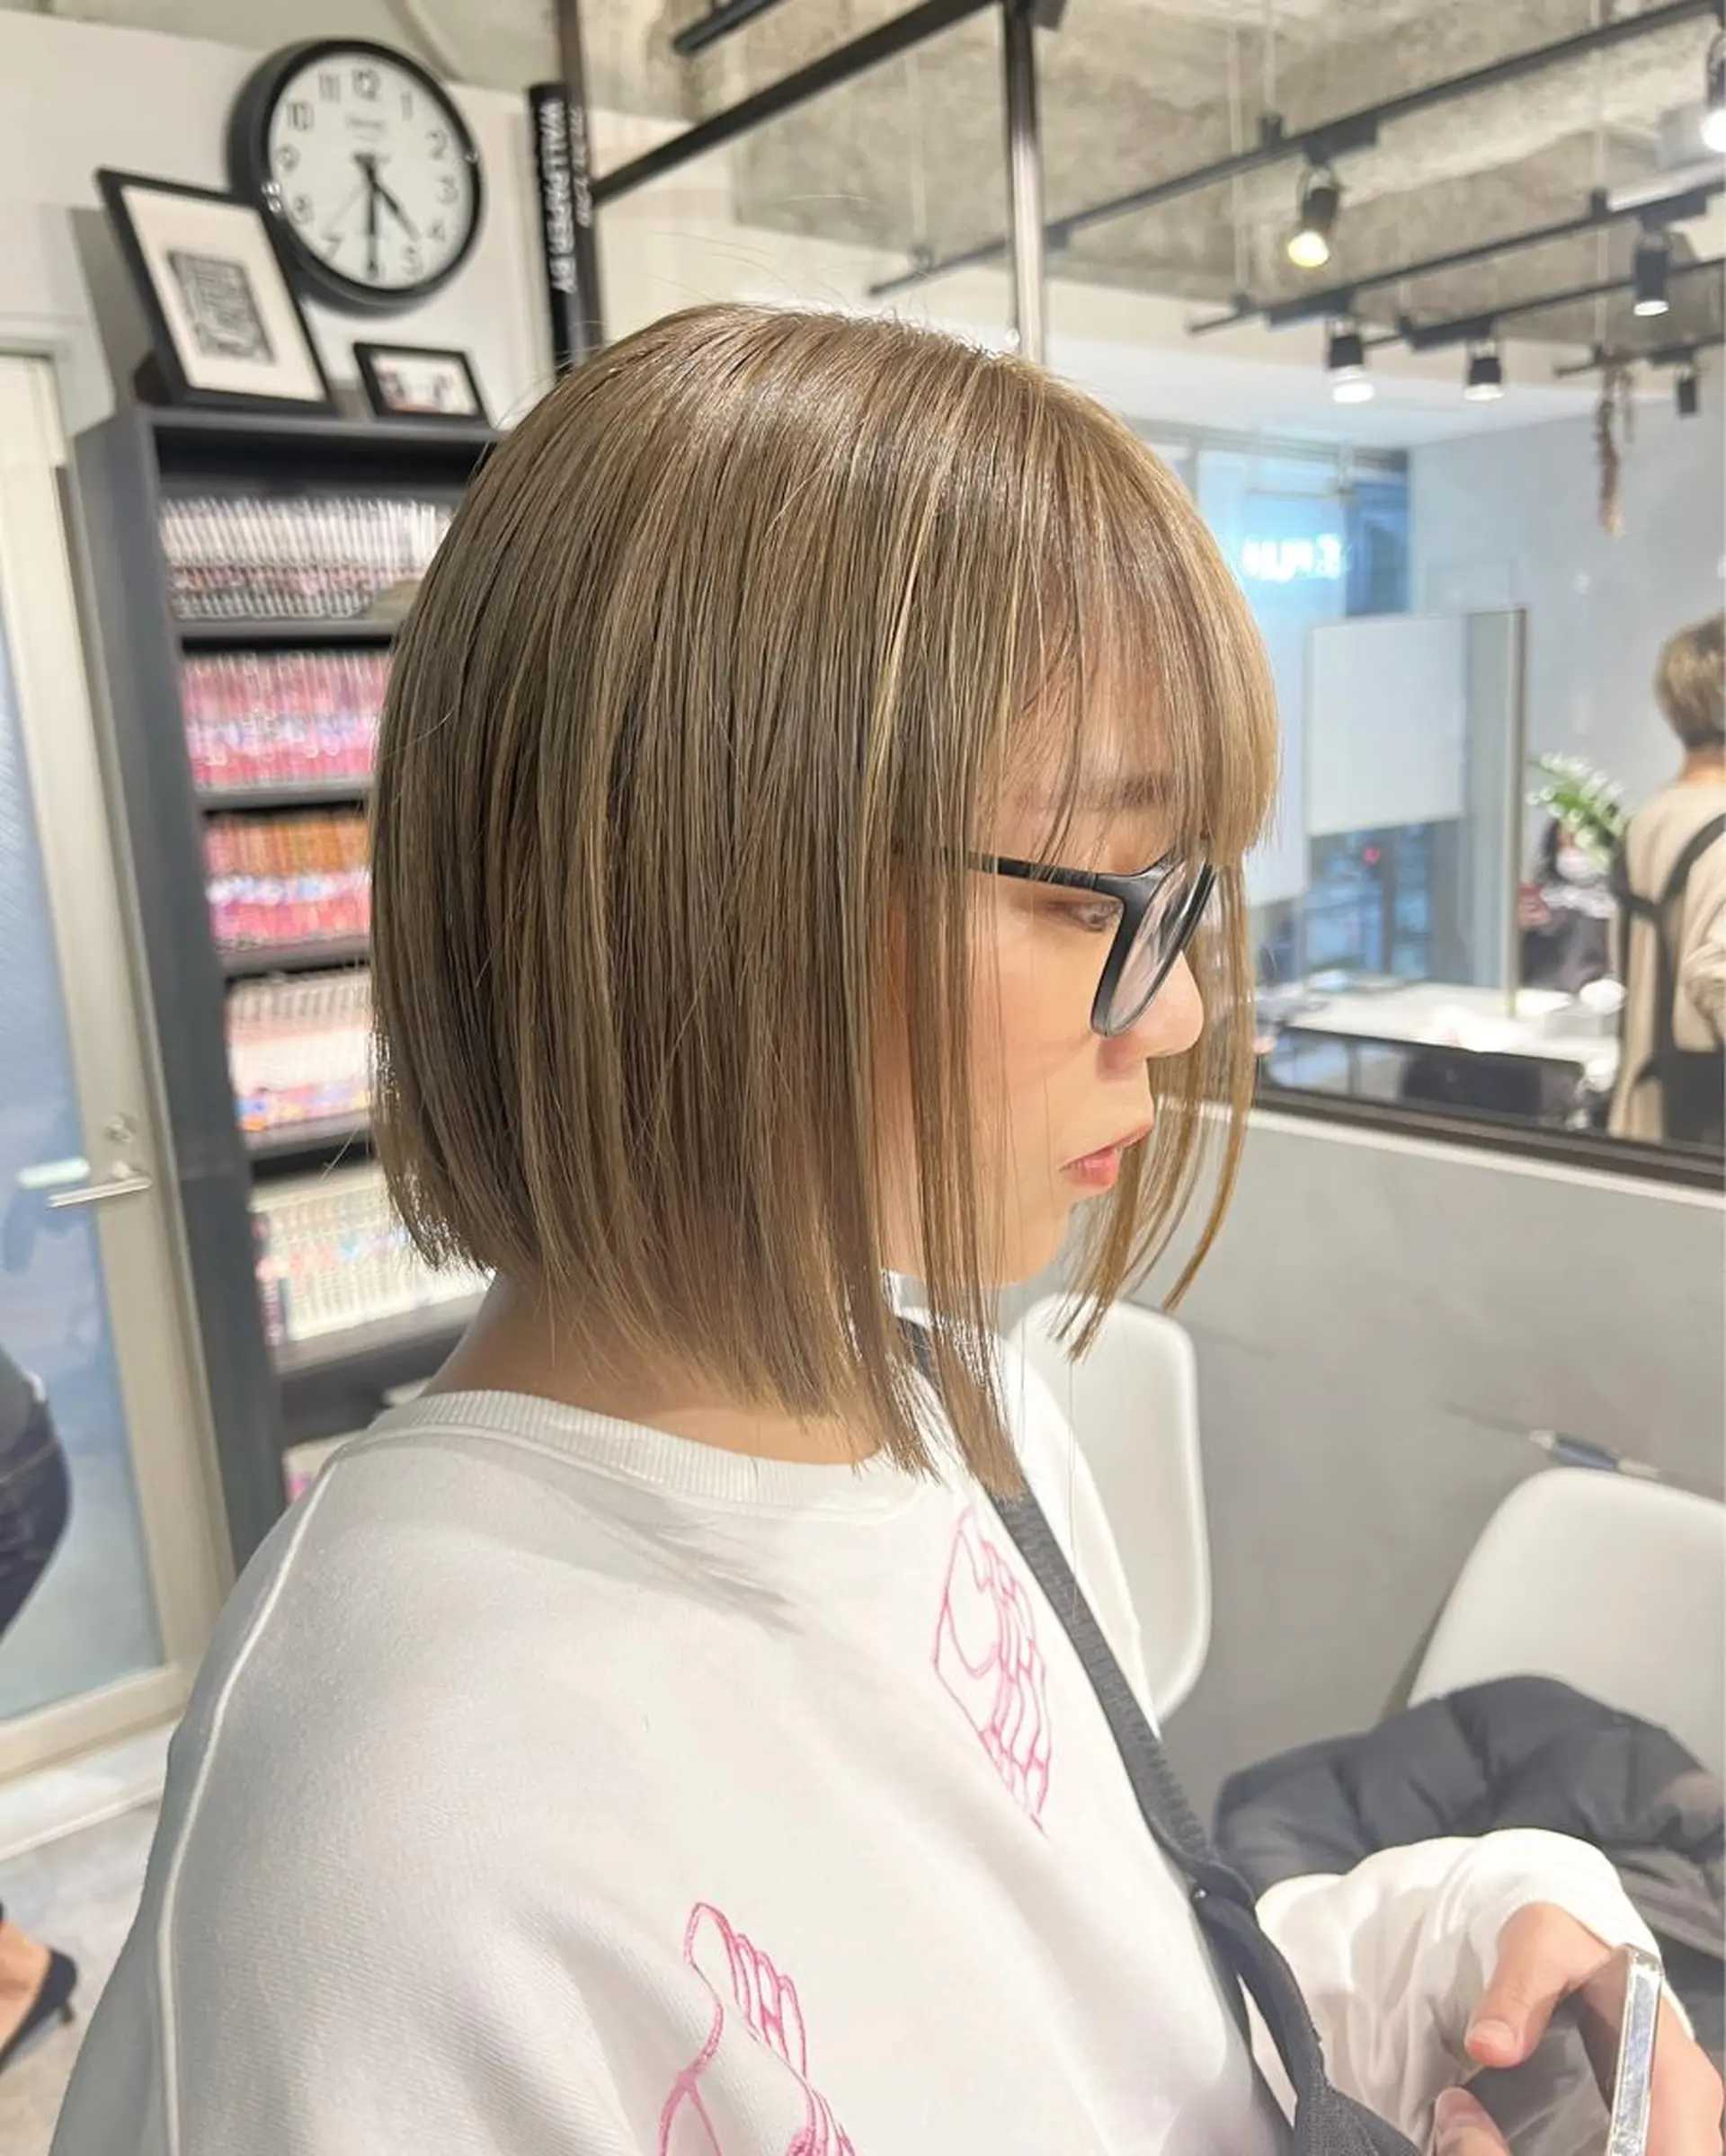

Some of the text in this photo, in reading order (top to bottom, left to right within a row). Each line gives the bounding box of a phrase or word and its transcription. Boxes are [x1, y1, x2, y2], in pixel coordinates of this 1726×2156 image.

[351, 67, 380, 101] 12
[427, 129, 448, 158] 2
[278, 144, 300, 174] 9
[437, 177, 458, 205] 3
